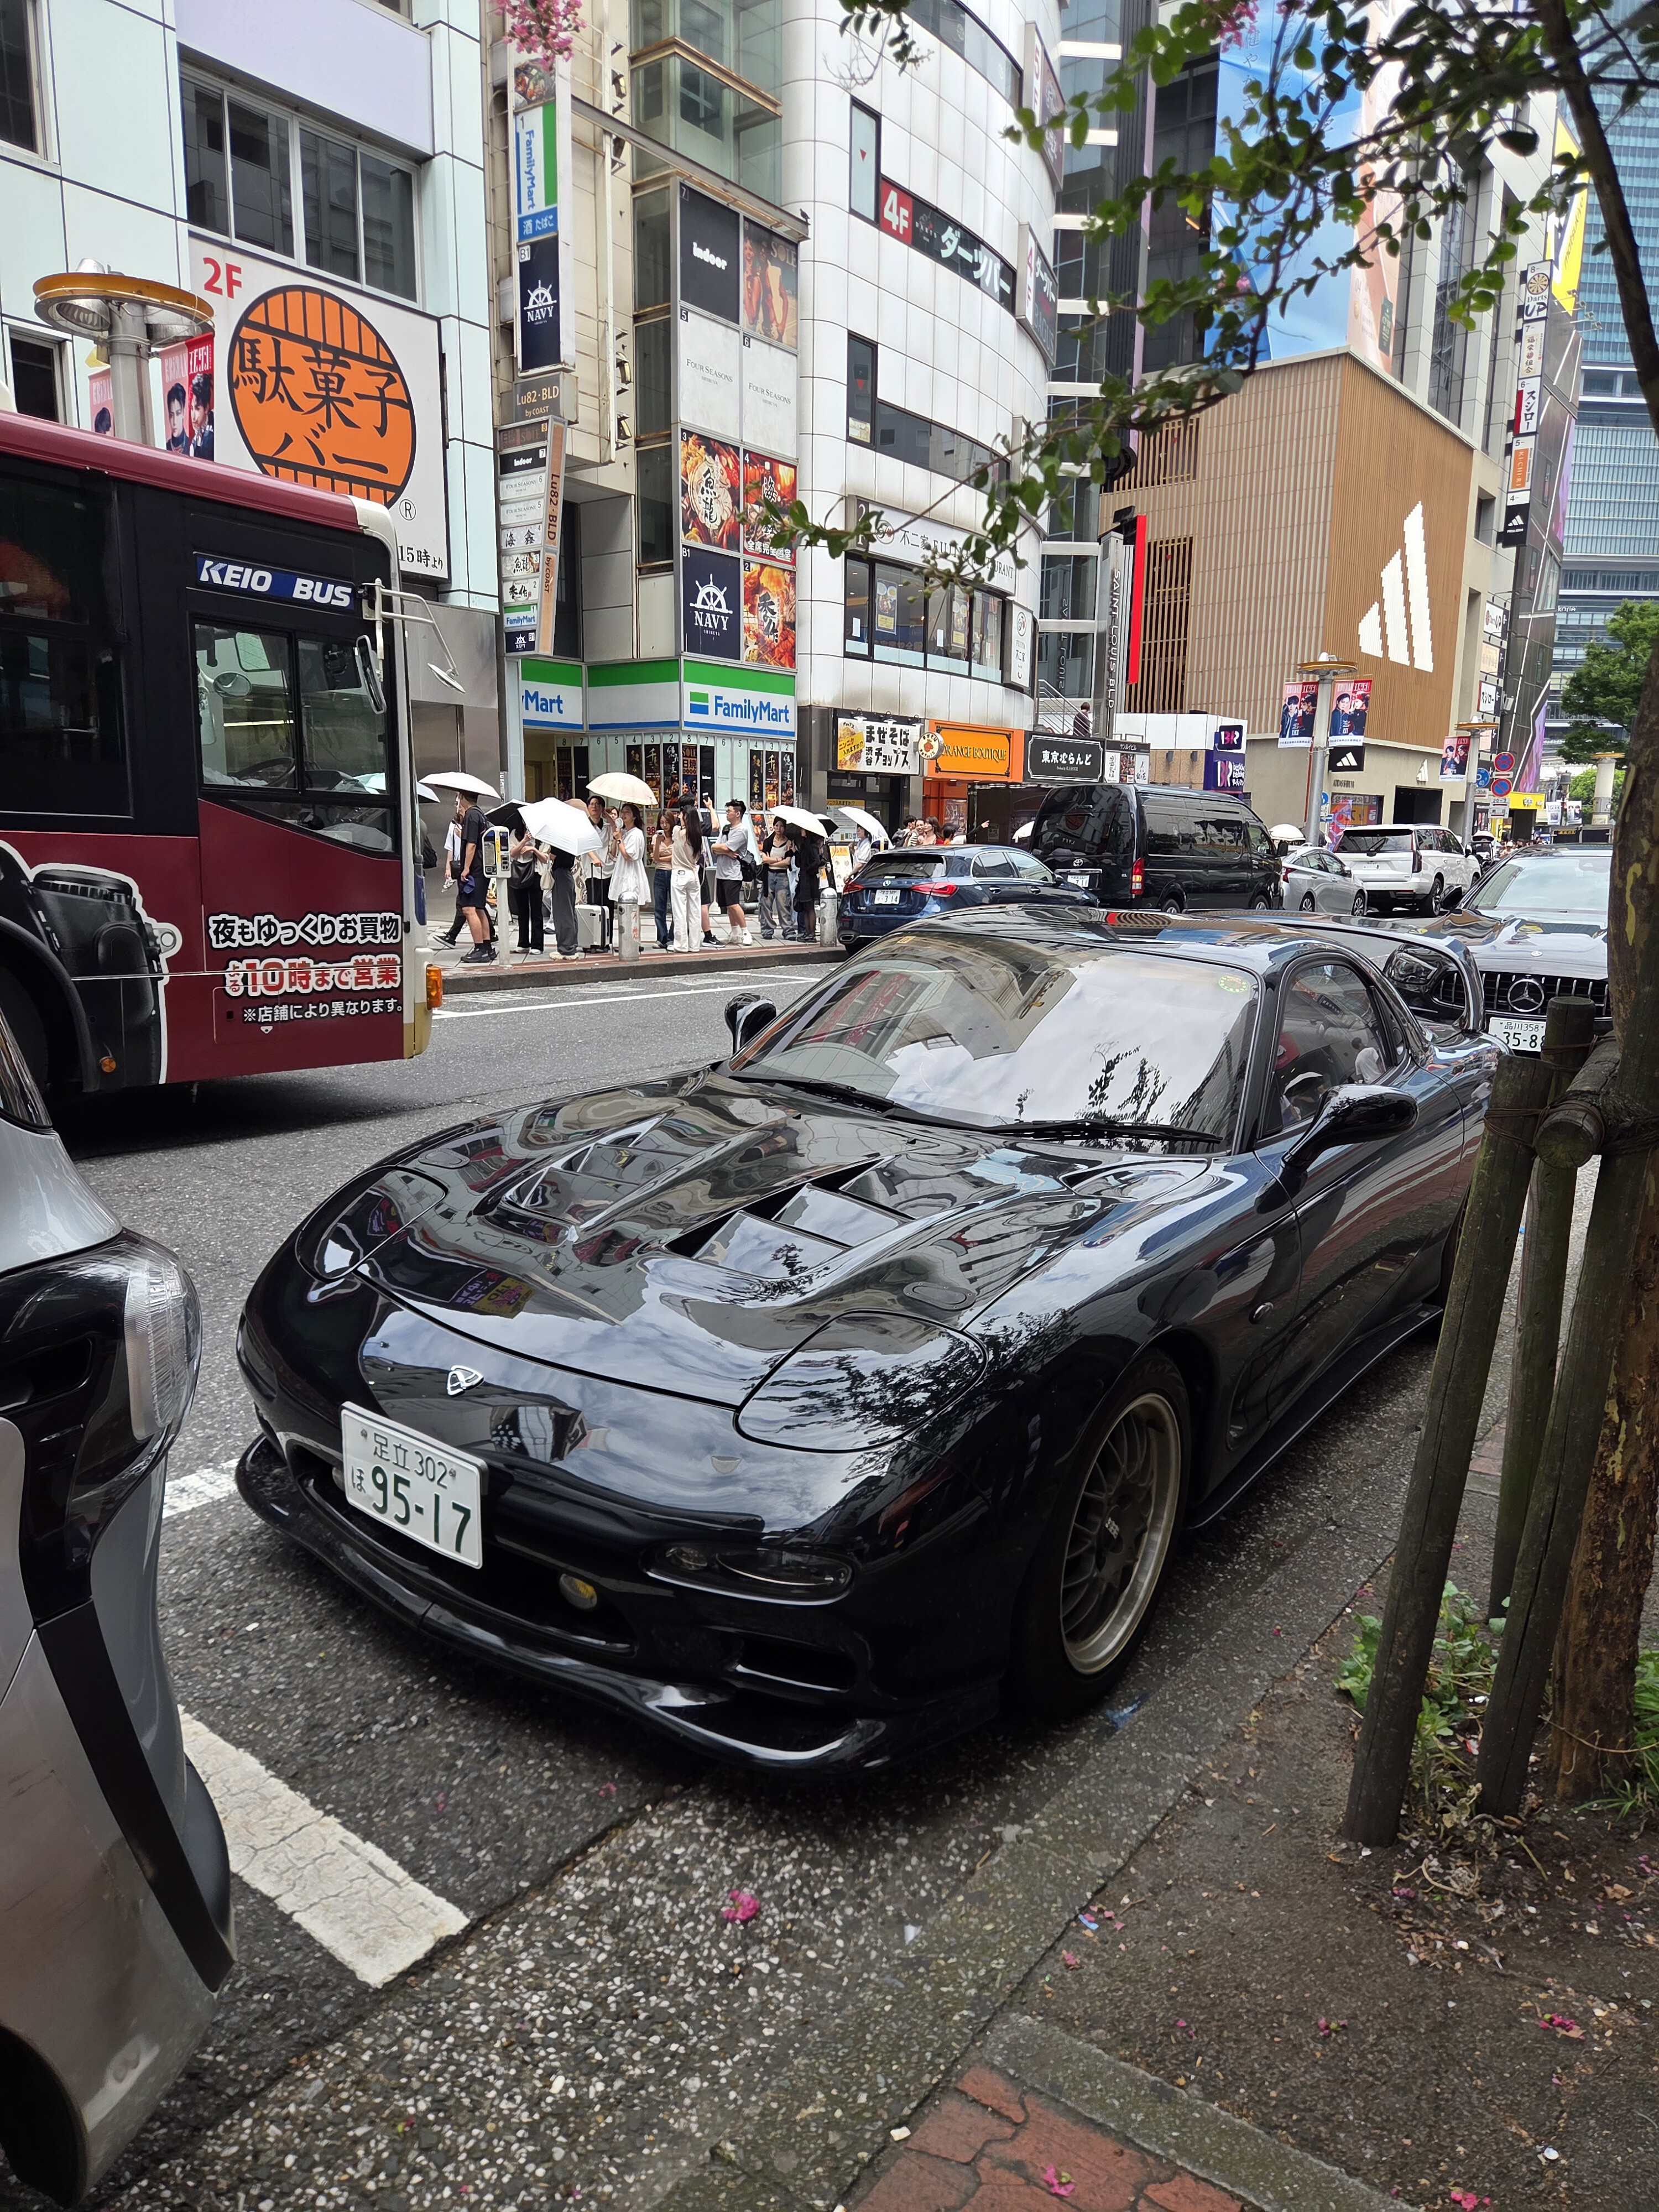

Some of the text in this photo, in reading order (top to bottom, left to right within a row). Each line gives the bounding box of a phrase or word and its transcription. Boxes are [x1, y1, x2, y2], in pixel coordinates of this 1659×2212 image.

[520, 116, 524, 129] 1
[525, 129, 535, 210] FamilyMart
[681, 187, 686, 197] 7
[884, 190, 909, 234] 4F
[520, 248, 530, 259] B1
[692, 241, 728, 270] indoor
[941, 226, 1010, 294] ダーツバー
[203, 257, 242, 299] 2F
[1035, 256, 1055, 303] ダーツバー
[527, 306, 554, 322] NAVY
[681, 310, 687, 321] 5
[1525, 302, 1547, 317] UP
[744, 337, 749, 347] 6
[686, 358, 704, 373] FOUR
[705, 364, 733, 383] SEASONS
[234, 337, 410, 438] 駄菓子
[748, 382, 764, 397] FOUR
[765, 388, 791, 405] SEASONS
[525, 405, 549, 418] by COAST
[1525, 390, 1536, 430] スシロー
[682, 432, 687, 441] 3
[272, 422, 388, 474] バー
[744, 453, 749, 463] 4
[701, 467, 718, 523] 魚龍
[900, 528, 929, 550] 不二家
[545, 557, 552, 567] by
[682, 545, 690, 557] B1
[200, 560, 352, 607] KEIO BUS
[1111, 568, 1121, 619] SAINT
[506, 615, 535, 626] FamilyMart
[694, 610, 729, 631] NAVY
[1016, 650, 1025, 662] 不二家
[1109, 623, 1118, 672] LOUIS
[1481, 691, 1494, 704] スシロー
[714, 695, 790, 724] FamilyMart
[839, 739, 854, 750] ニンニク
[866, 725, 909, 747] まぜそば
[866, 747, 909, 768] 渋谷 チョップス
[942, 744, 1006, 762] ORANGE BOUTIQUE
[211, 915, 400, 947] 夜もゆっくりお買物
[351, 1465, 471, 1553] ほ 95-17
